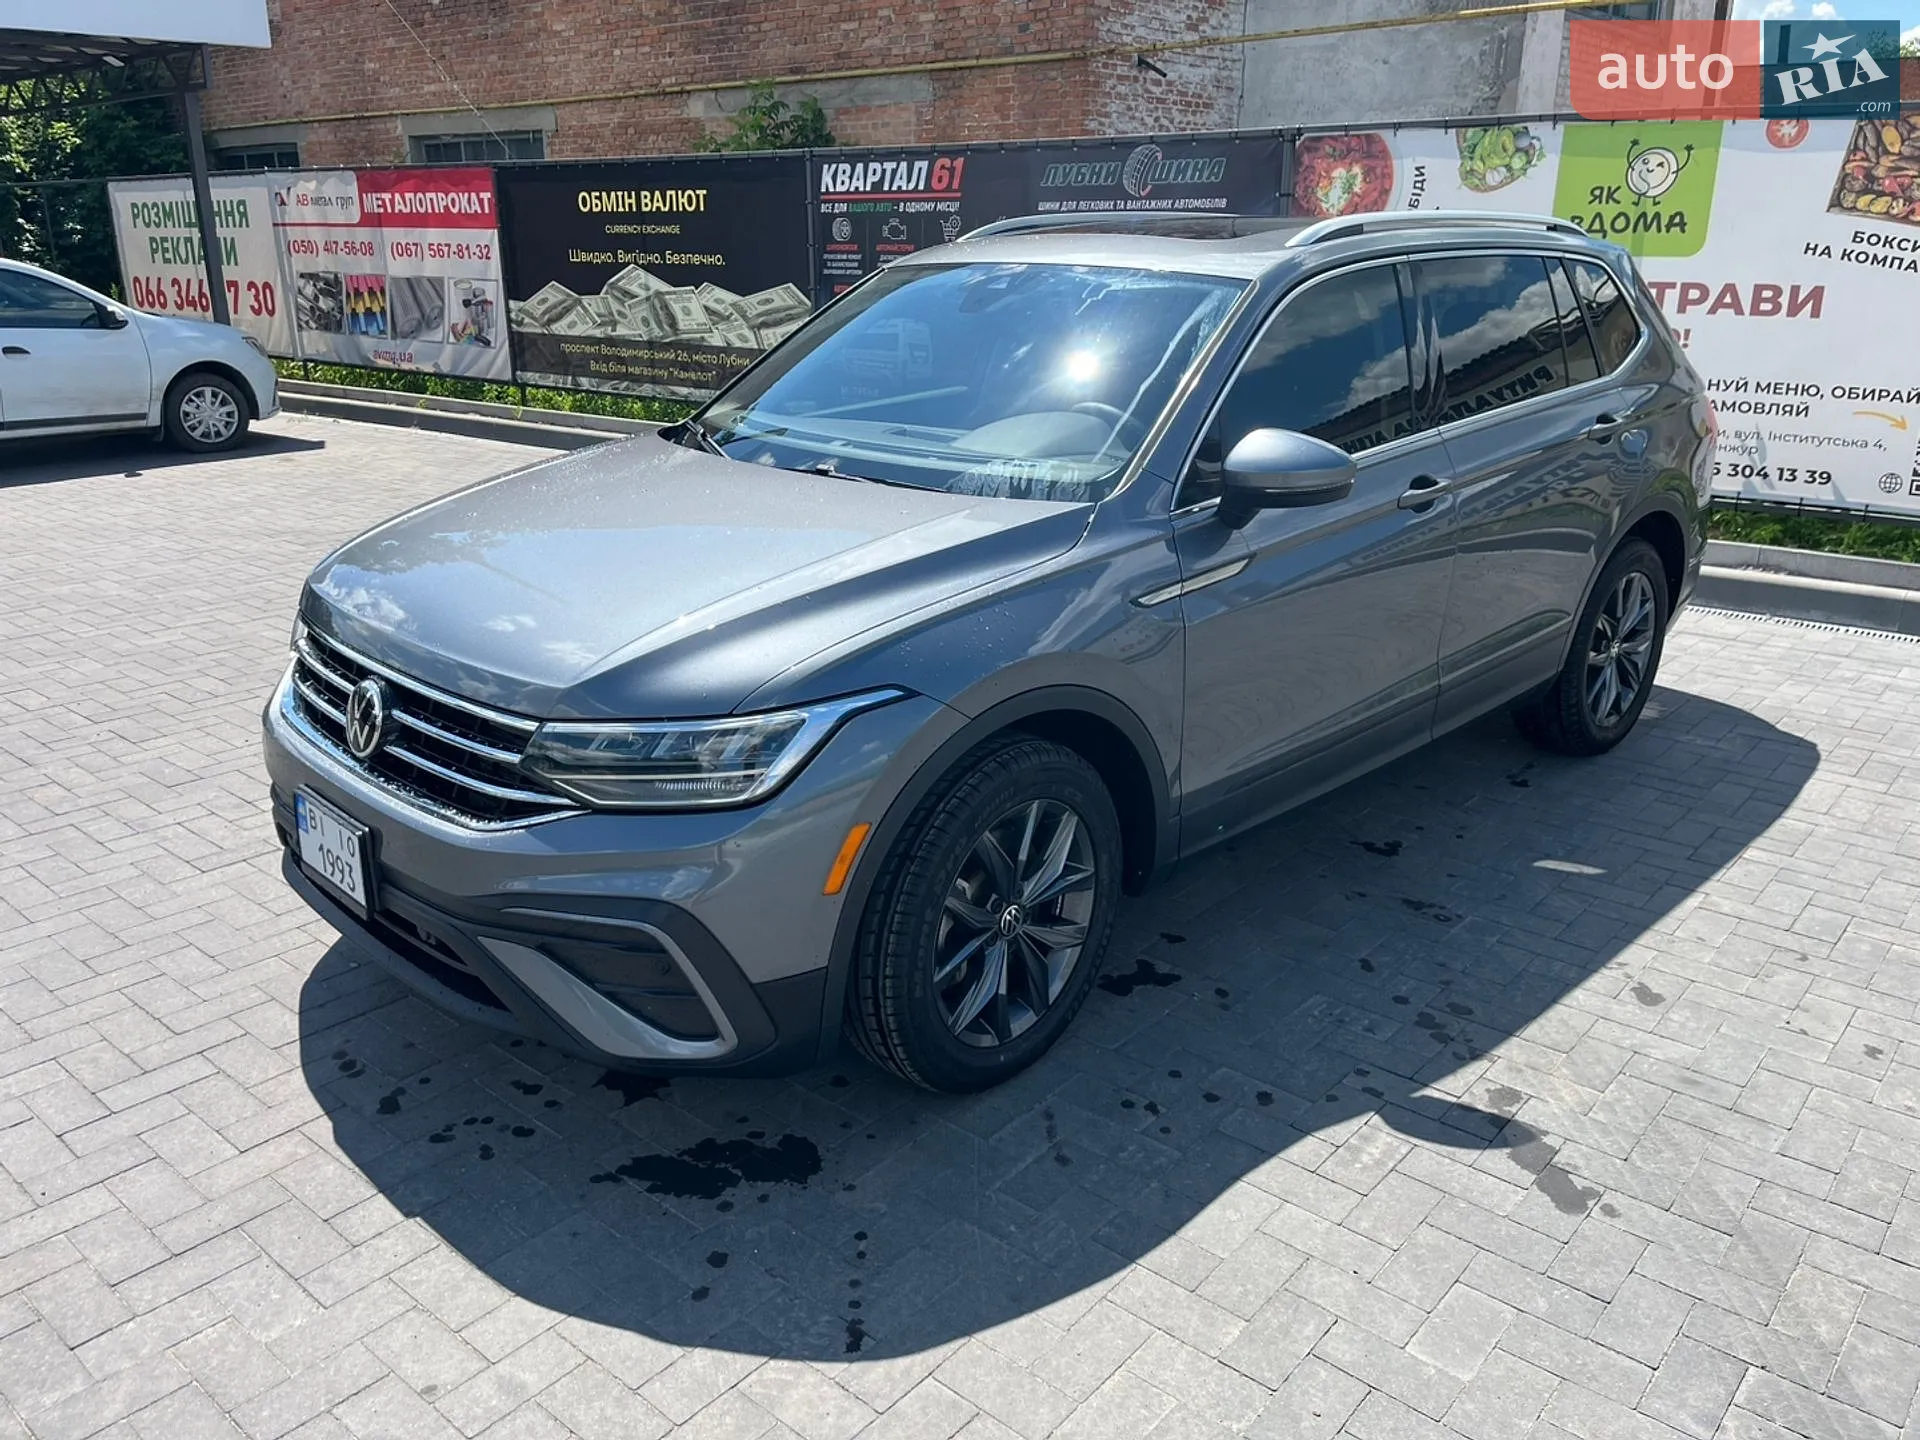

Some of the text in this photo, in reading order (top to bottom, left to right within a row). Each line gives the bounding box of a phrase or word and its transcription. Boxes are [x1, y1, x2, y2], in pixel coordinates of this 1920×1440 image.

[820, 157, 964, 192] КВАРТАЛ 61
[1148, 158, 1226, 184] ШИНА
[1408, 165, 1426, 210] БІДИ
[1588, 186, 1621, 205] ЯК
[362, 191, 492, 215] МЕТАЛОПРОКАТ
[578, 189, 707, 212] ОБМІН ВАЛЮТ
[821, 202, 832, 213] ВСЕ
[905, 202, 936, 213] ОДНОМУ
[1038, 200, 1060, 211] ШИНИ
[1061, 200, 1077, 212] ДЛЯ
[1116, 199, 1125, 211] ТА
[1126, 199, 1172, 210] ВАНТАЖНИХ
[1174, 198, 1227, 210] АВТОМОБІЛІВ
[130, 199, 249, 229] РОЗМІЩННЯ
[605, 225, 681, 235] CURRENCY EXCHANGE
[149, 236, 239, 266] РЕКЛАИ
[287, 239, 319, 257] (050)
[390, 241, 424, 261] (067)
[428, 242, 492, 261] 567-81-32
[568, 249, 726, 266] Швидко. Вигідно. Безпечно.
[1804, 242, 1832, 259] НА
[133, 276, 167, 310] 066
[171, 277, 210, 312] 346
[247, 280, 276, 317] 30
[560, 343, 599, 354] проспект
[677, 349, 691, 361] 26,
[719, 353, 750, 368] Лубни
[1707, 377, 1920, 405] НУЙ МЕНЮ, ОБИРАЙ
[1710, 399, 1810, 418] АМОВЛЯЙ
[1716, 443, 1759, 456] нжур
[1717, 429, 1888, 451] и, вул. Інститутська 4,
[1727, 463, 1770, 479] 304
[1776, 466, 1798, 482] 13
[1803, 470, 1833, 485] 39
[318, 843, 355, 893] 1993
